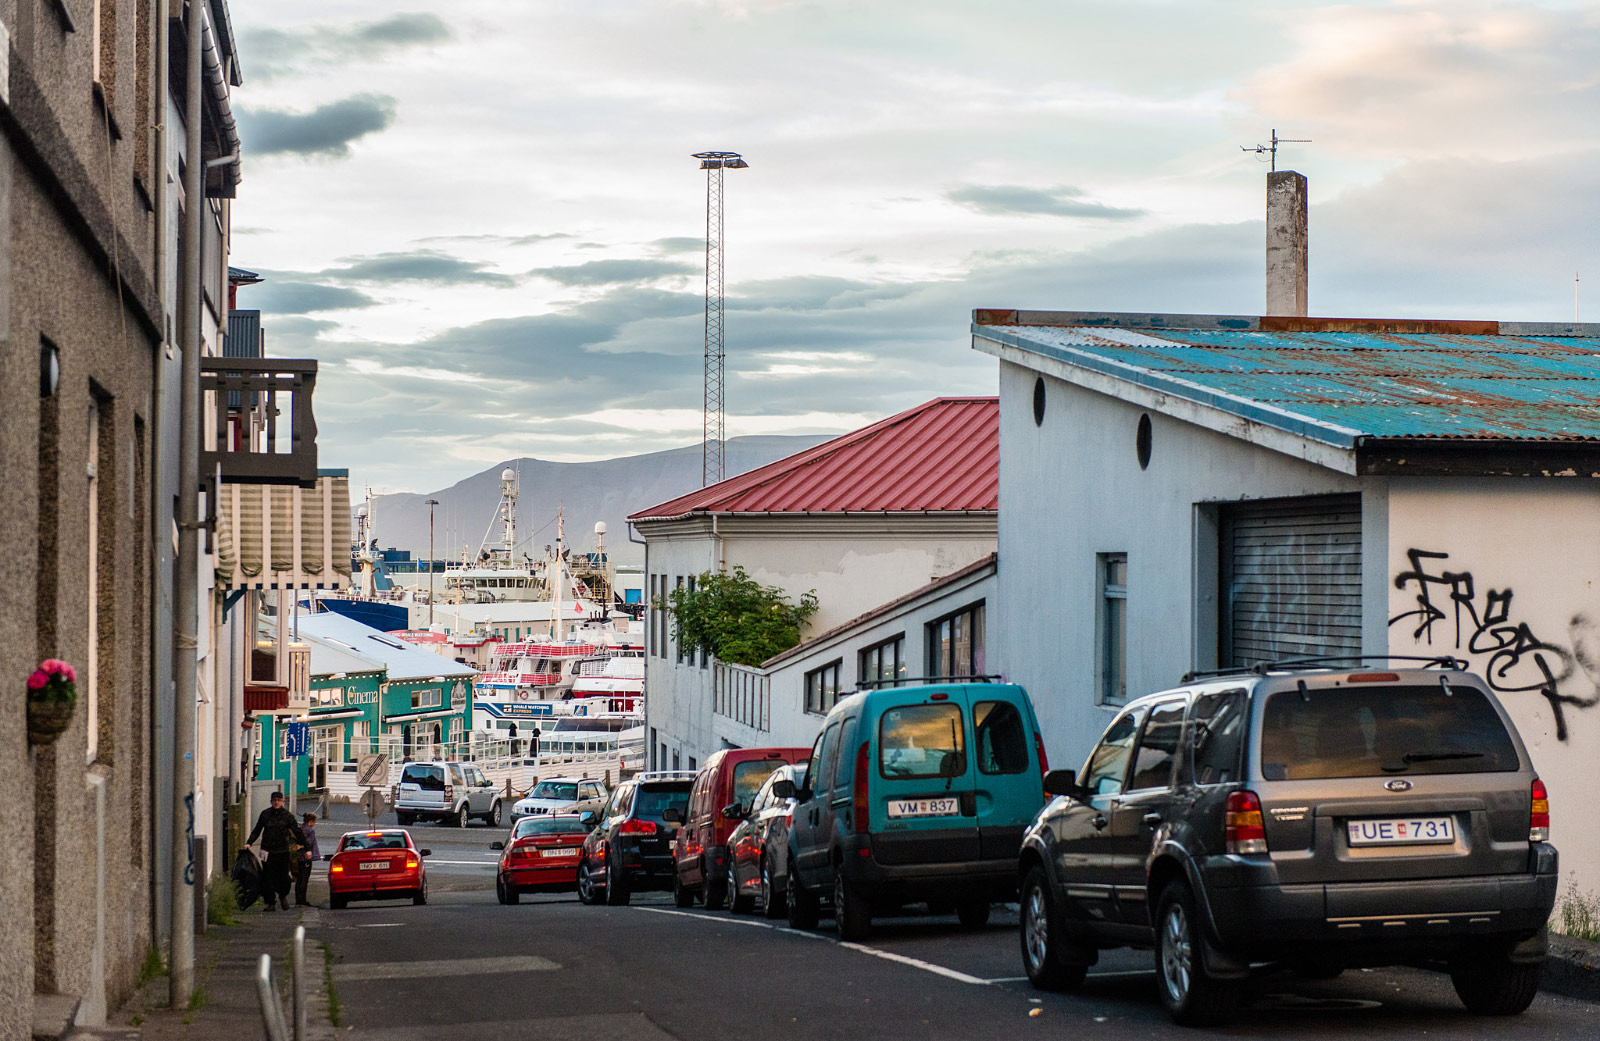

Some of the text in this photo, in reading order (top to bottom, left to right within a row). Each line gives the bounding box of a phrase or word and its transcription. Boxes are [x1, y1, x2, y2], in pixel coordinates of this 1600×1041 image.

[347, 686, 378, 704] Cinema
[898, 800, 954, 814] VM 837
[1362, 823, 1394, 840] UE
[1410, 821, 1448, 838] 731
